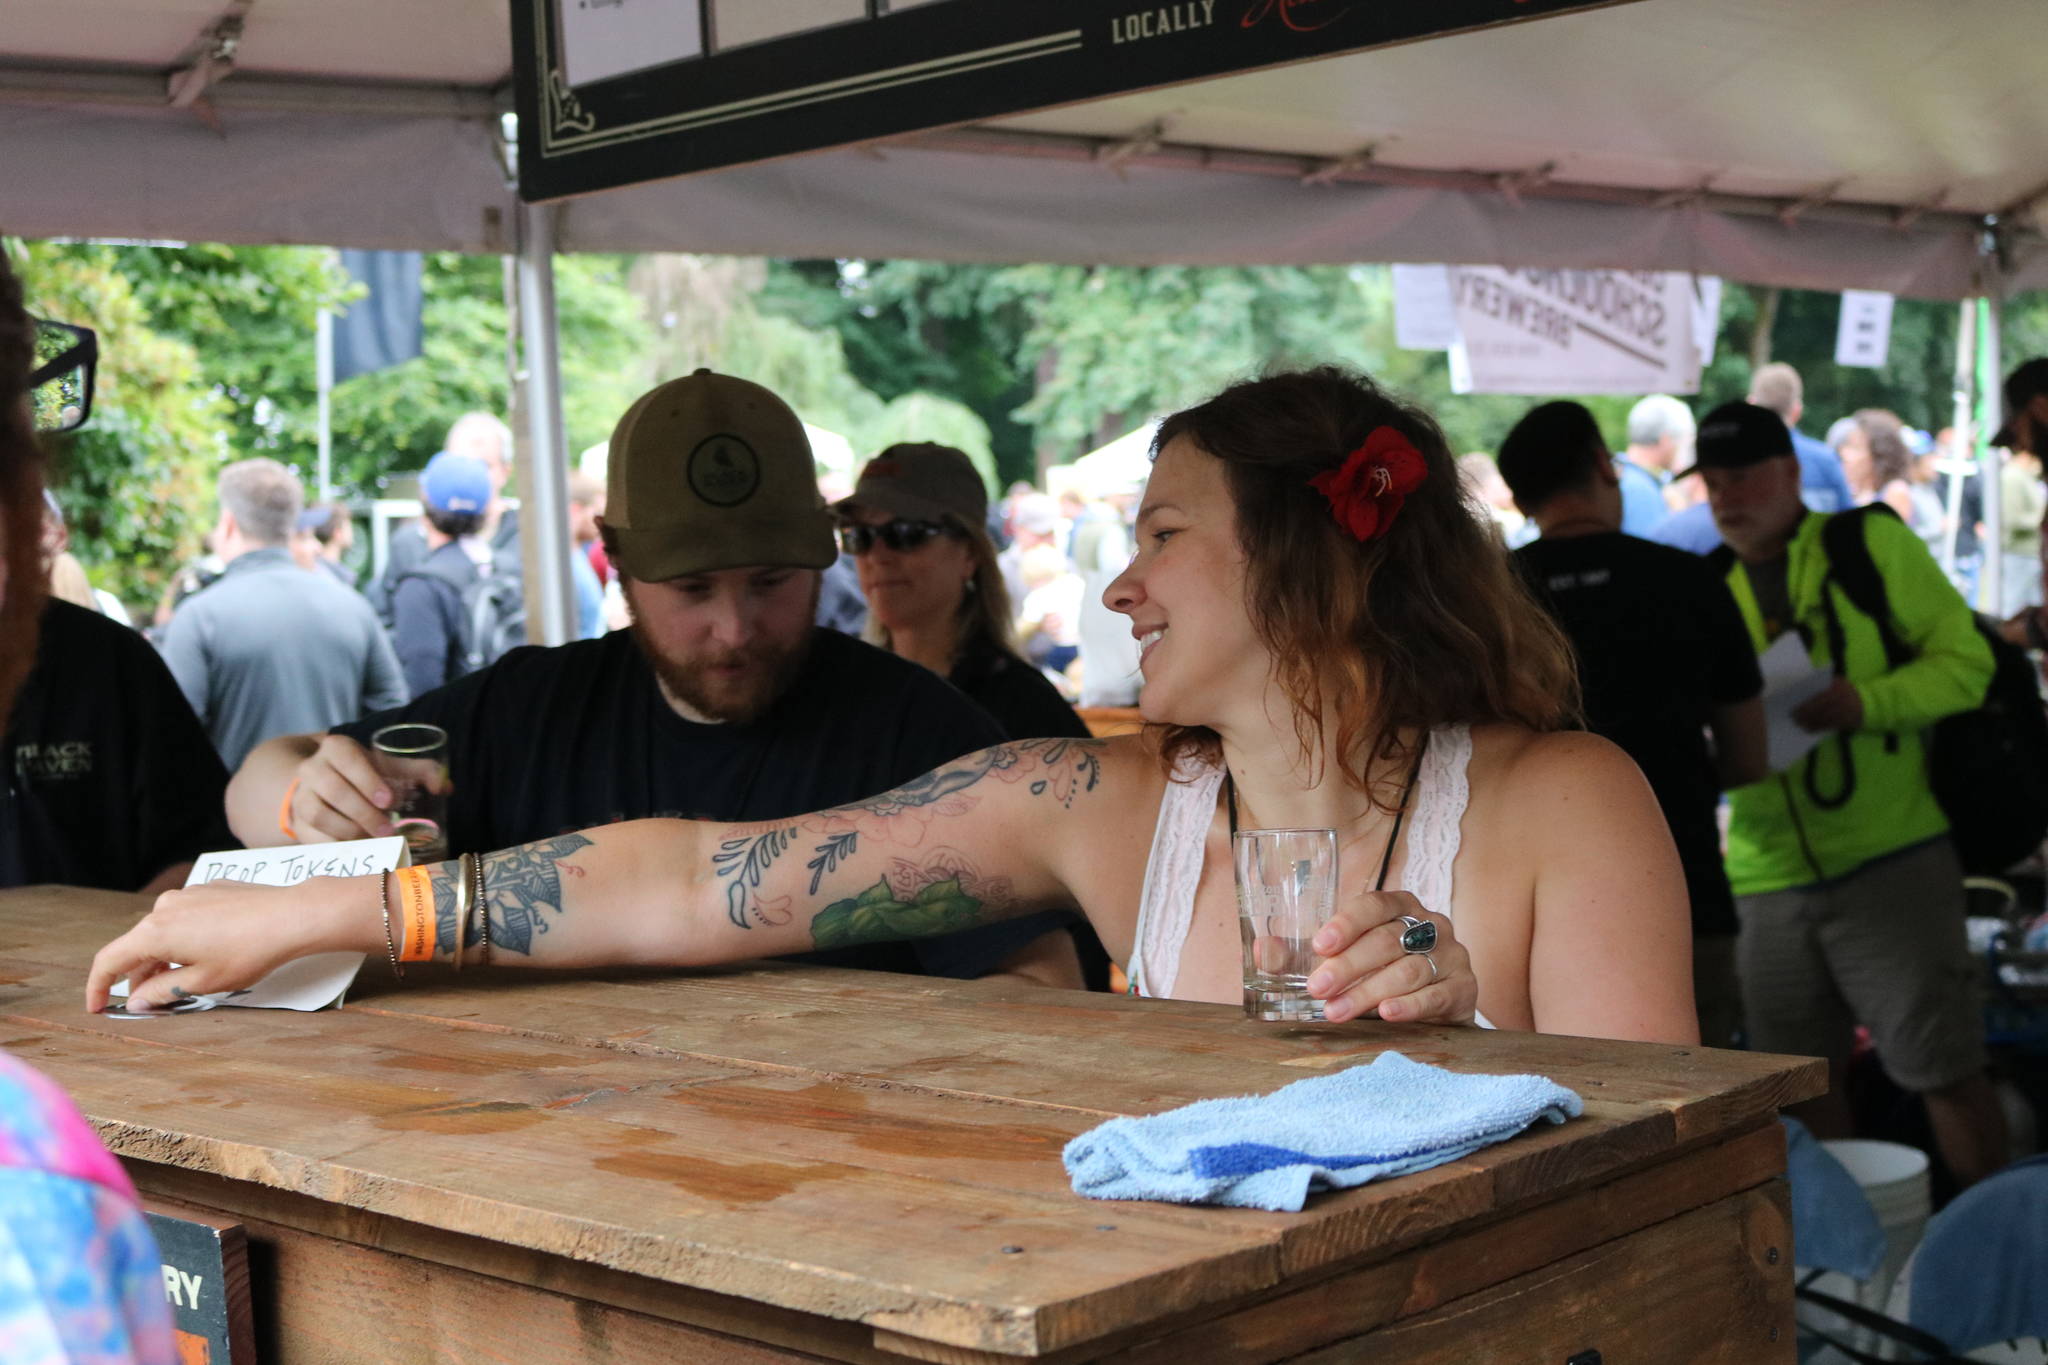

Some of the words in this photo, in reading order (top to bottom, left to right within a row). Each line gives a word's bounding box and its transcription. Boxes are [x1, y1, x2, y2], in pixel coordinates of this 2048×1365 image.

[1111, 0, 1215, 44] LOCALLY
[204, 861, 268, 883] DROP
[281, 854, 374, 884] TOKENS
